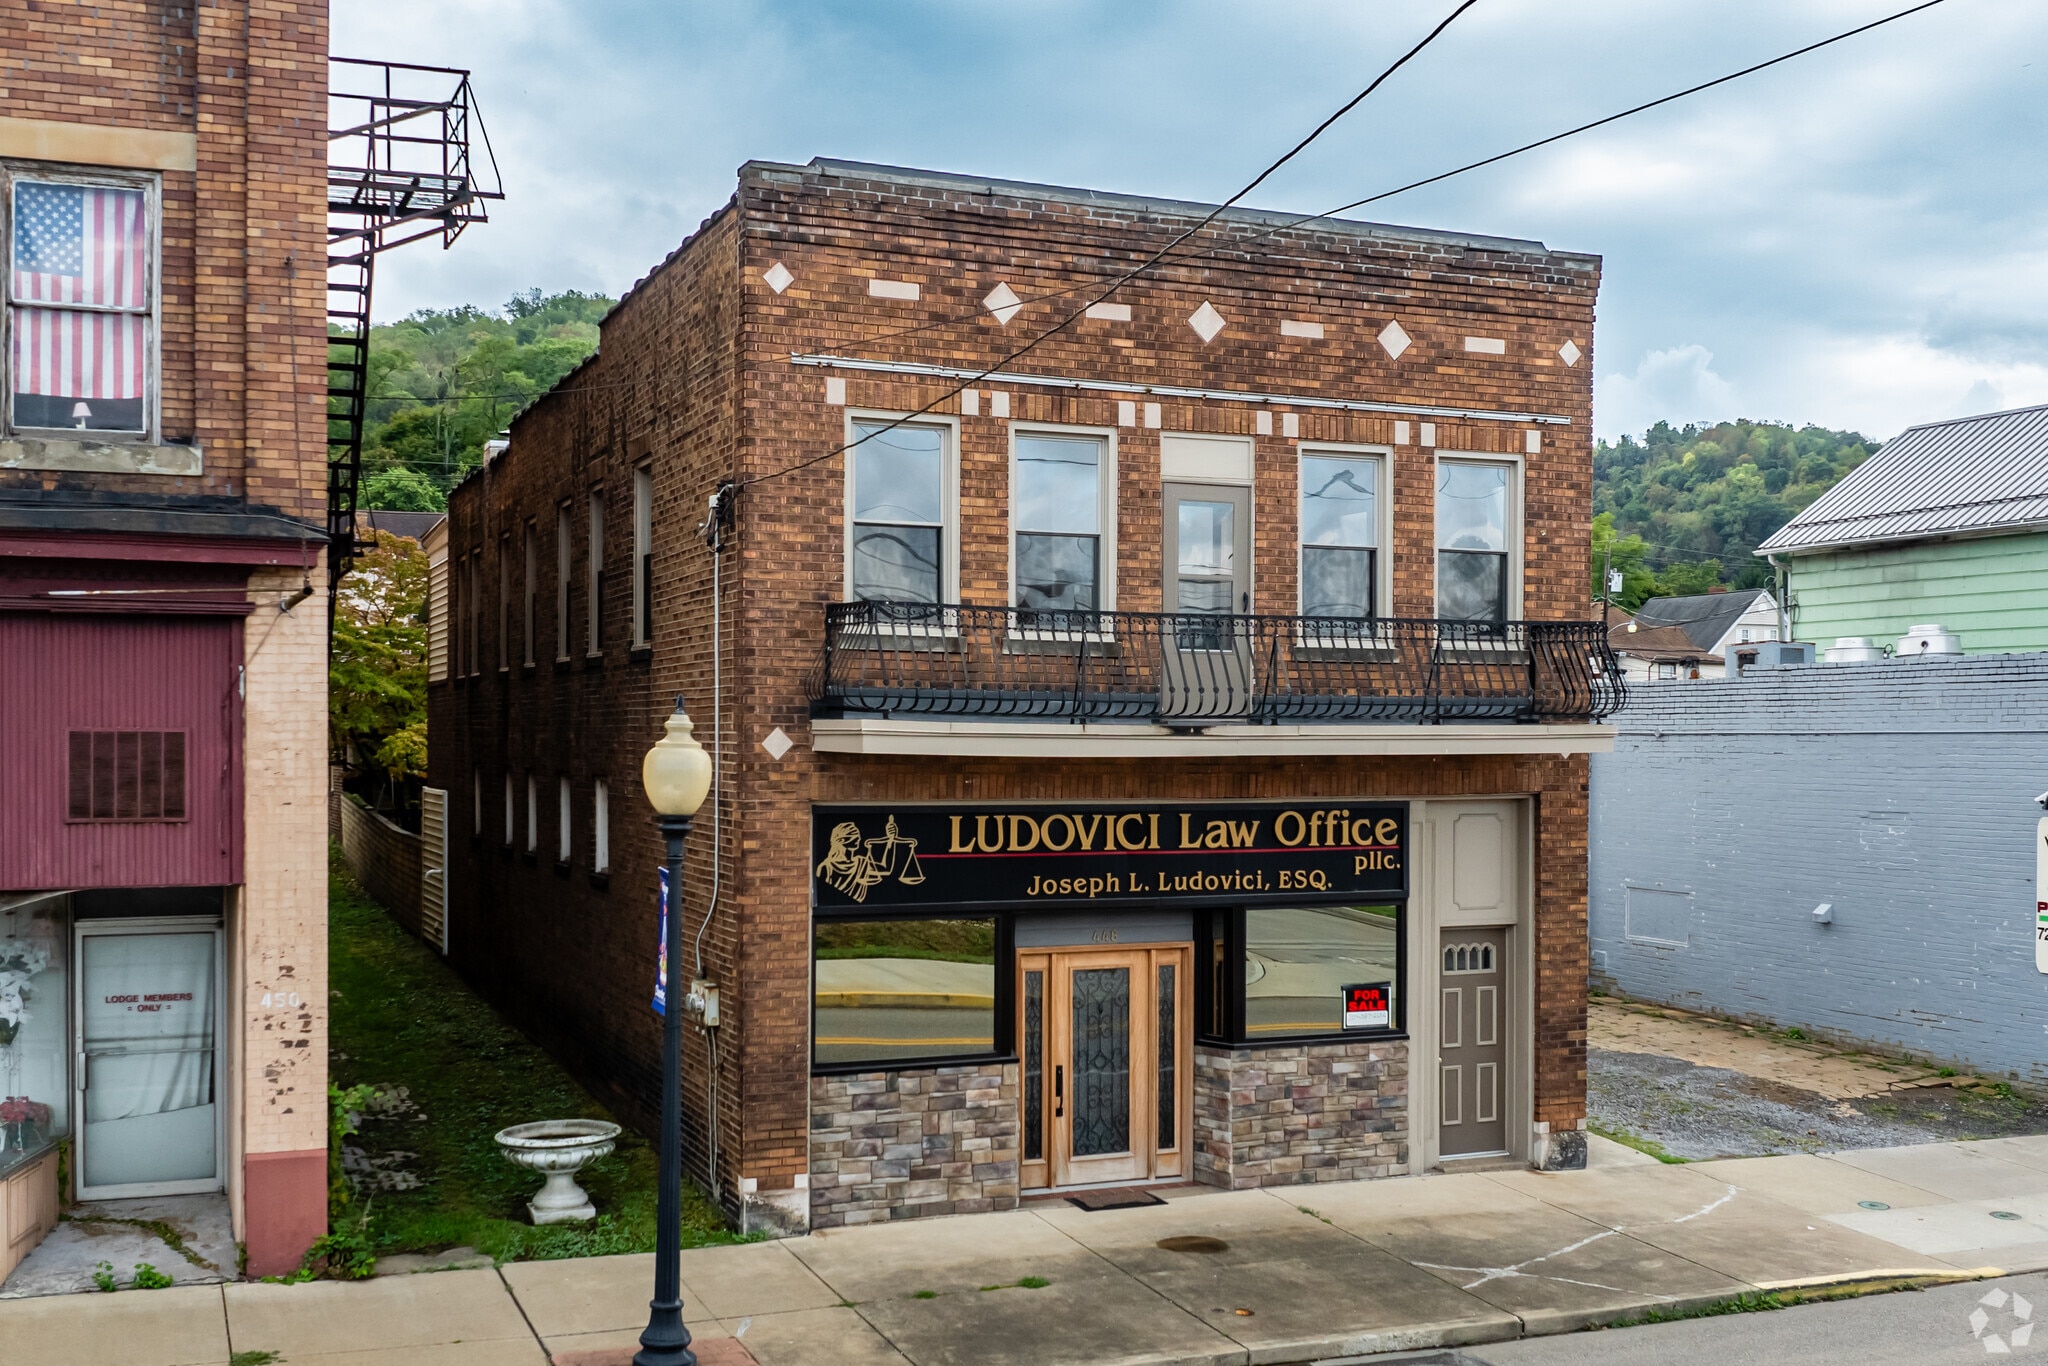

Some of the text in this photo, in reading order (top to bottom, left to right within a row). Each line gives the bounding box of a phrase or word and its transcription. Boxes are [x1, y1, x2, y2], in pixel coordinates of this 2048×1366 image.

[948, 809, 1399, 853] LUDOVICI Law Office
[1354, 851, 1401, 875] pllc.
[1026, 869, 1333, 898] Joseph L. Ludovici, ESQ.
[1092, 928, 1119, 944] 448
[105, 992, 193, 1004] LODGE MEMBERS
[260, 991, 300, 1009] 450
[1354, 989, 1380, 1001] FOR
[137, 1003, 162, 1013] ONLY
[1348, 1000, 1387, 1011] SALE
